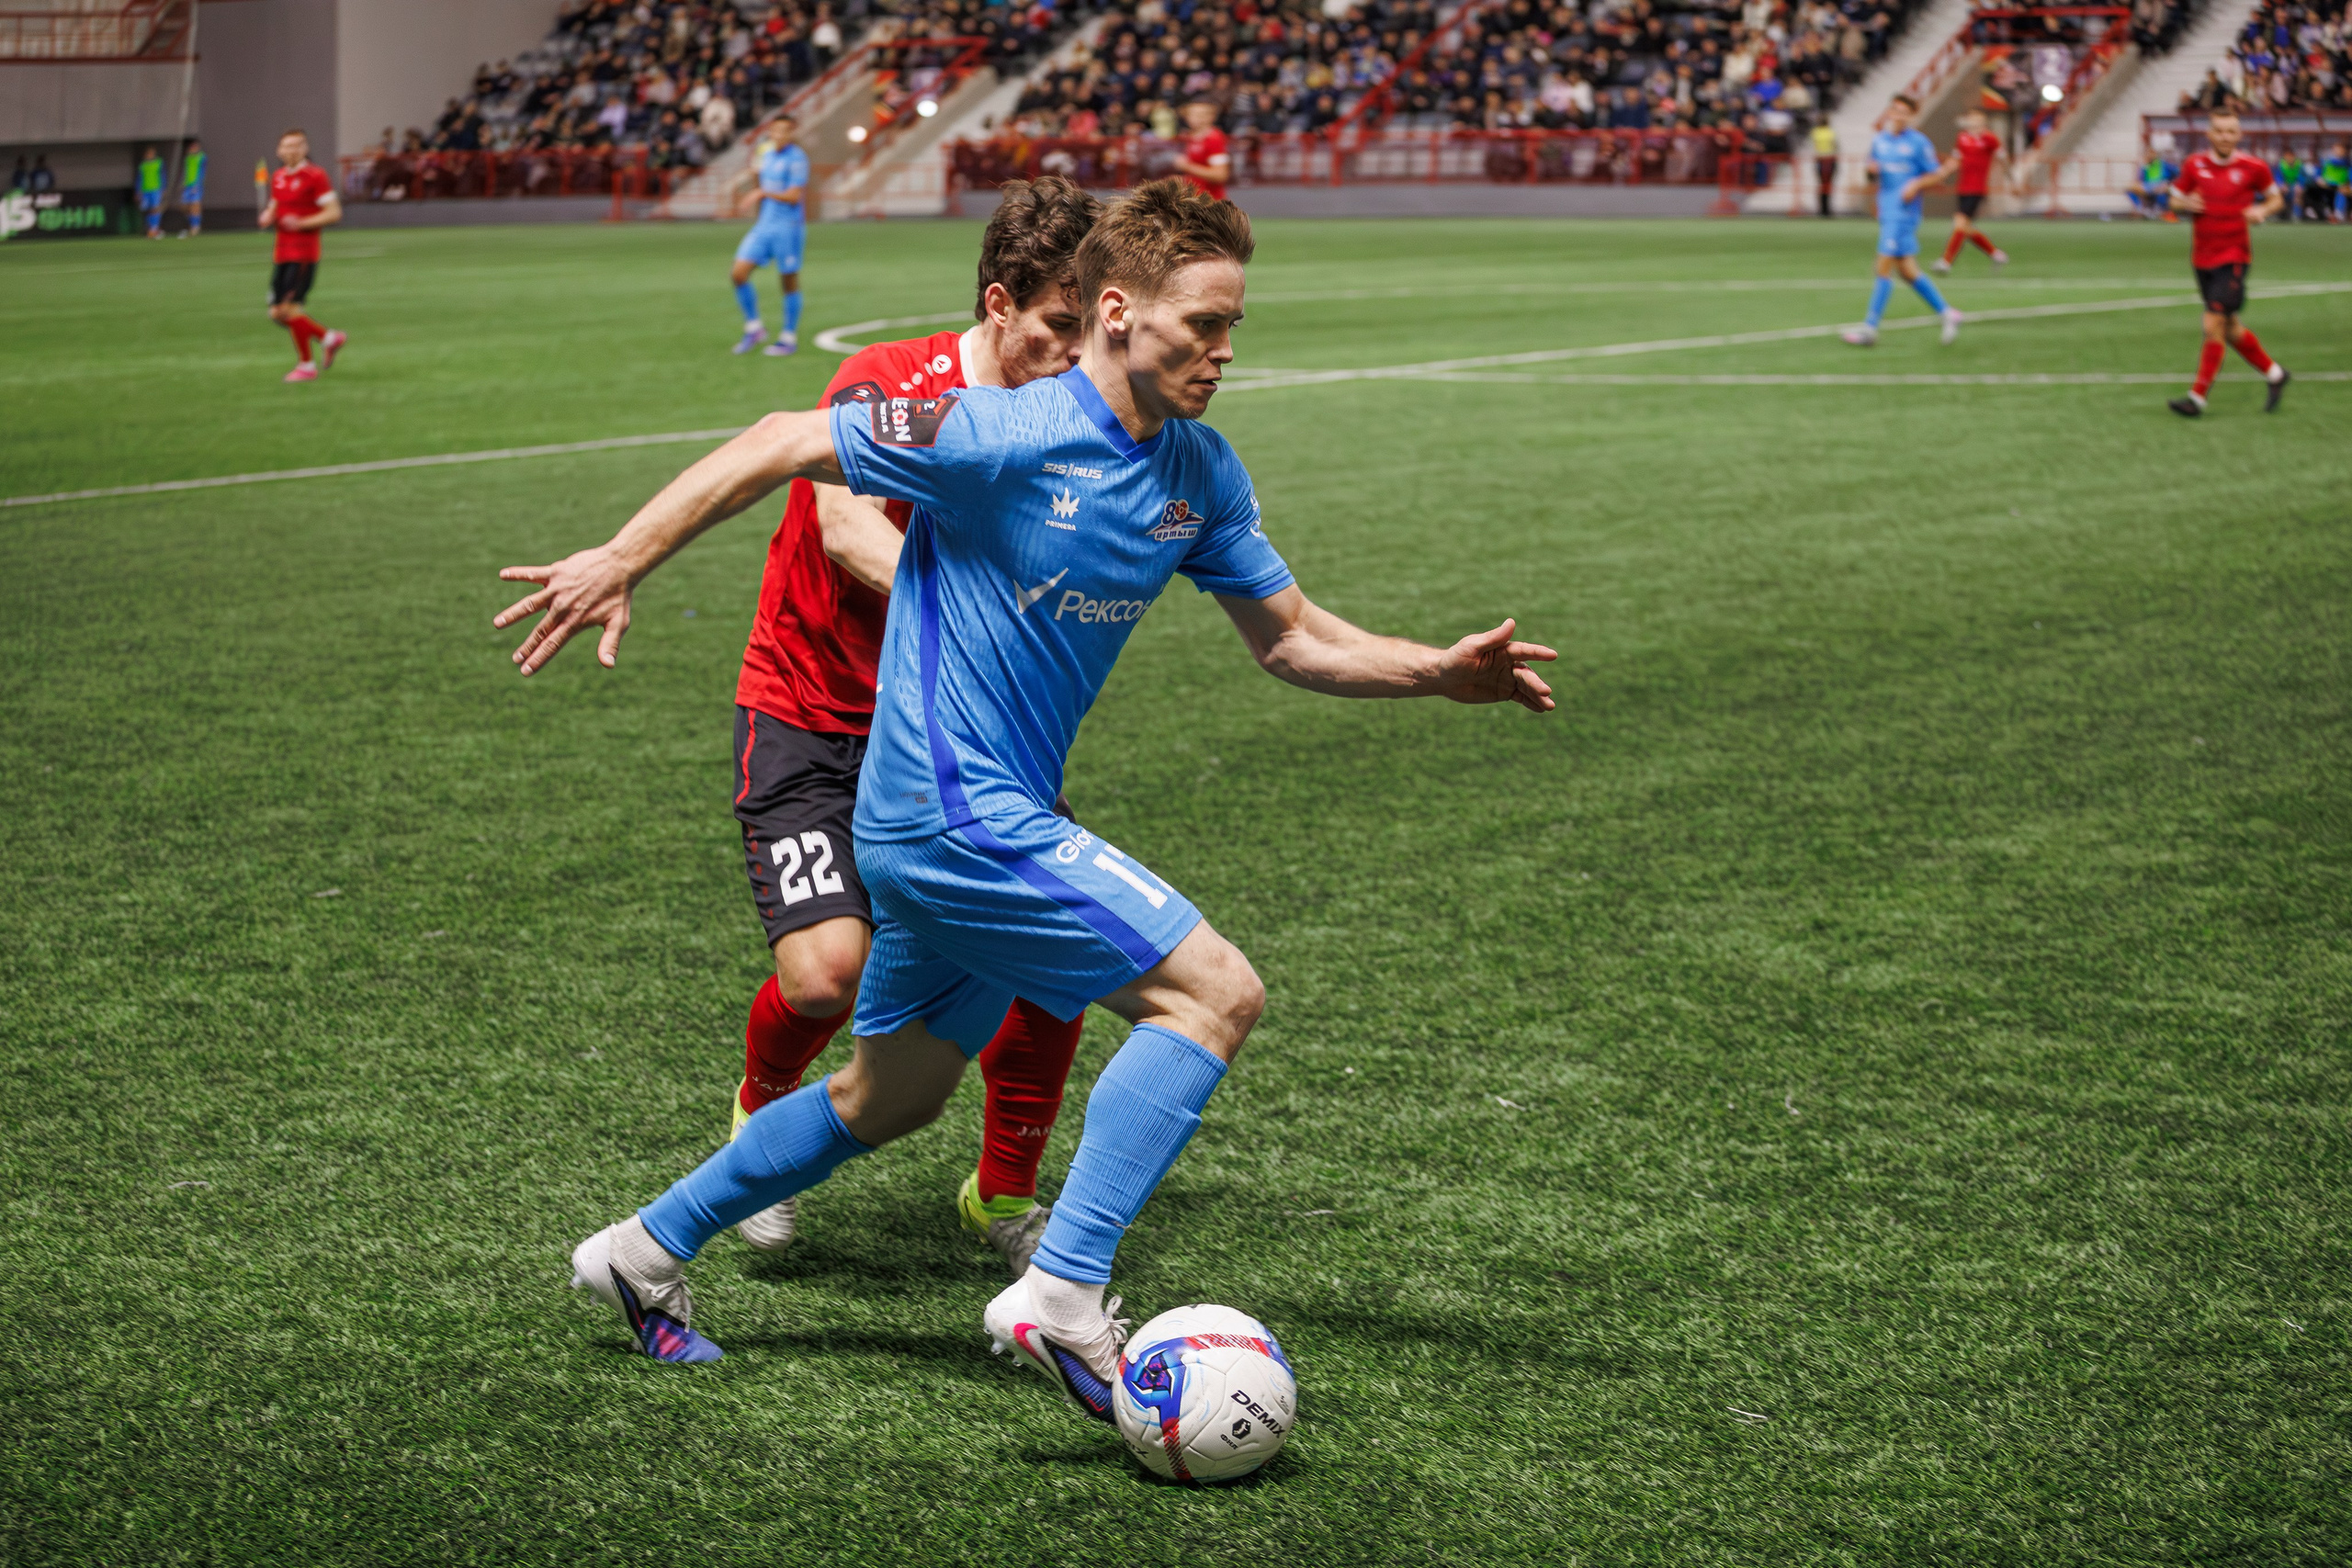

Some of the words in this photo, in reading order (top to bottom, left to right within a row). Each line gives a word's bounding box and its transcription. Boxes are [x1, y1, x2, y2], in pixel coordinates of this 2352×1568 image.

[770, 830, 845, 907] 22
[1230, 1390, 1286, 1438] DEMIX
[1220, 1433, 1239, 1450] ФНЛ
